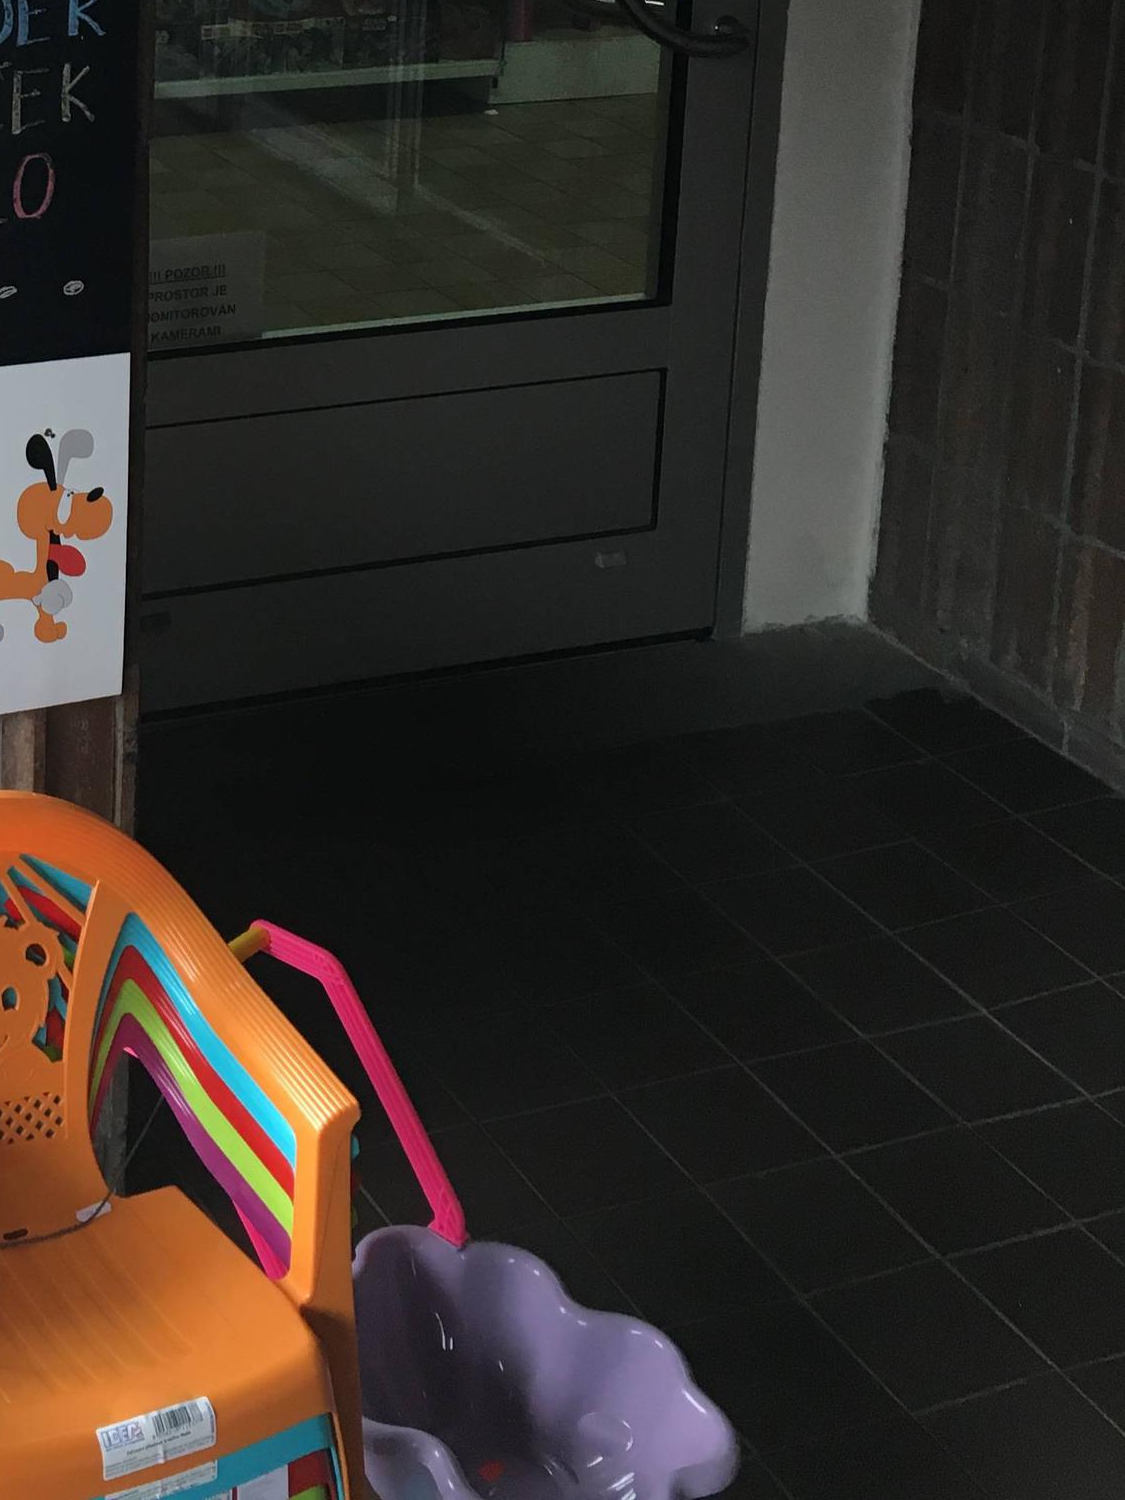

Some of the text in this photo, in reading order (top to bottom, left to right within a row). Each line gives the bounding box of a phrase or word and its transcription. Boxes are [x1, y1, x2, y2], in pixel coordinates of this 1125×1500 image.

[165, 265, 210, 280] POZOR
[212, 285, 227, 297] JE
[151, 325, 221, 342] KAMERAMI
